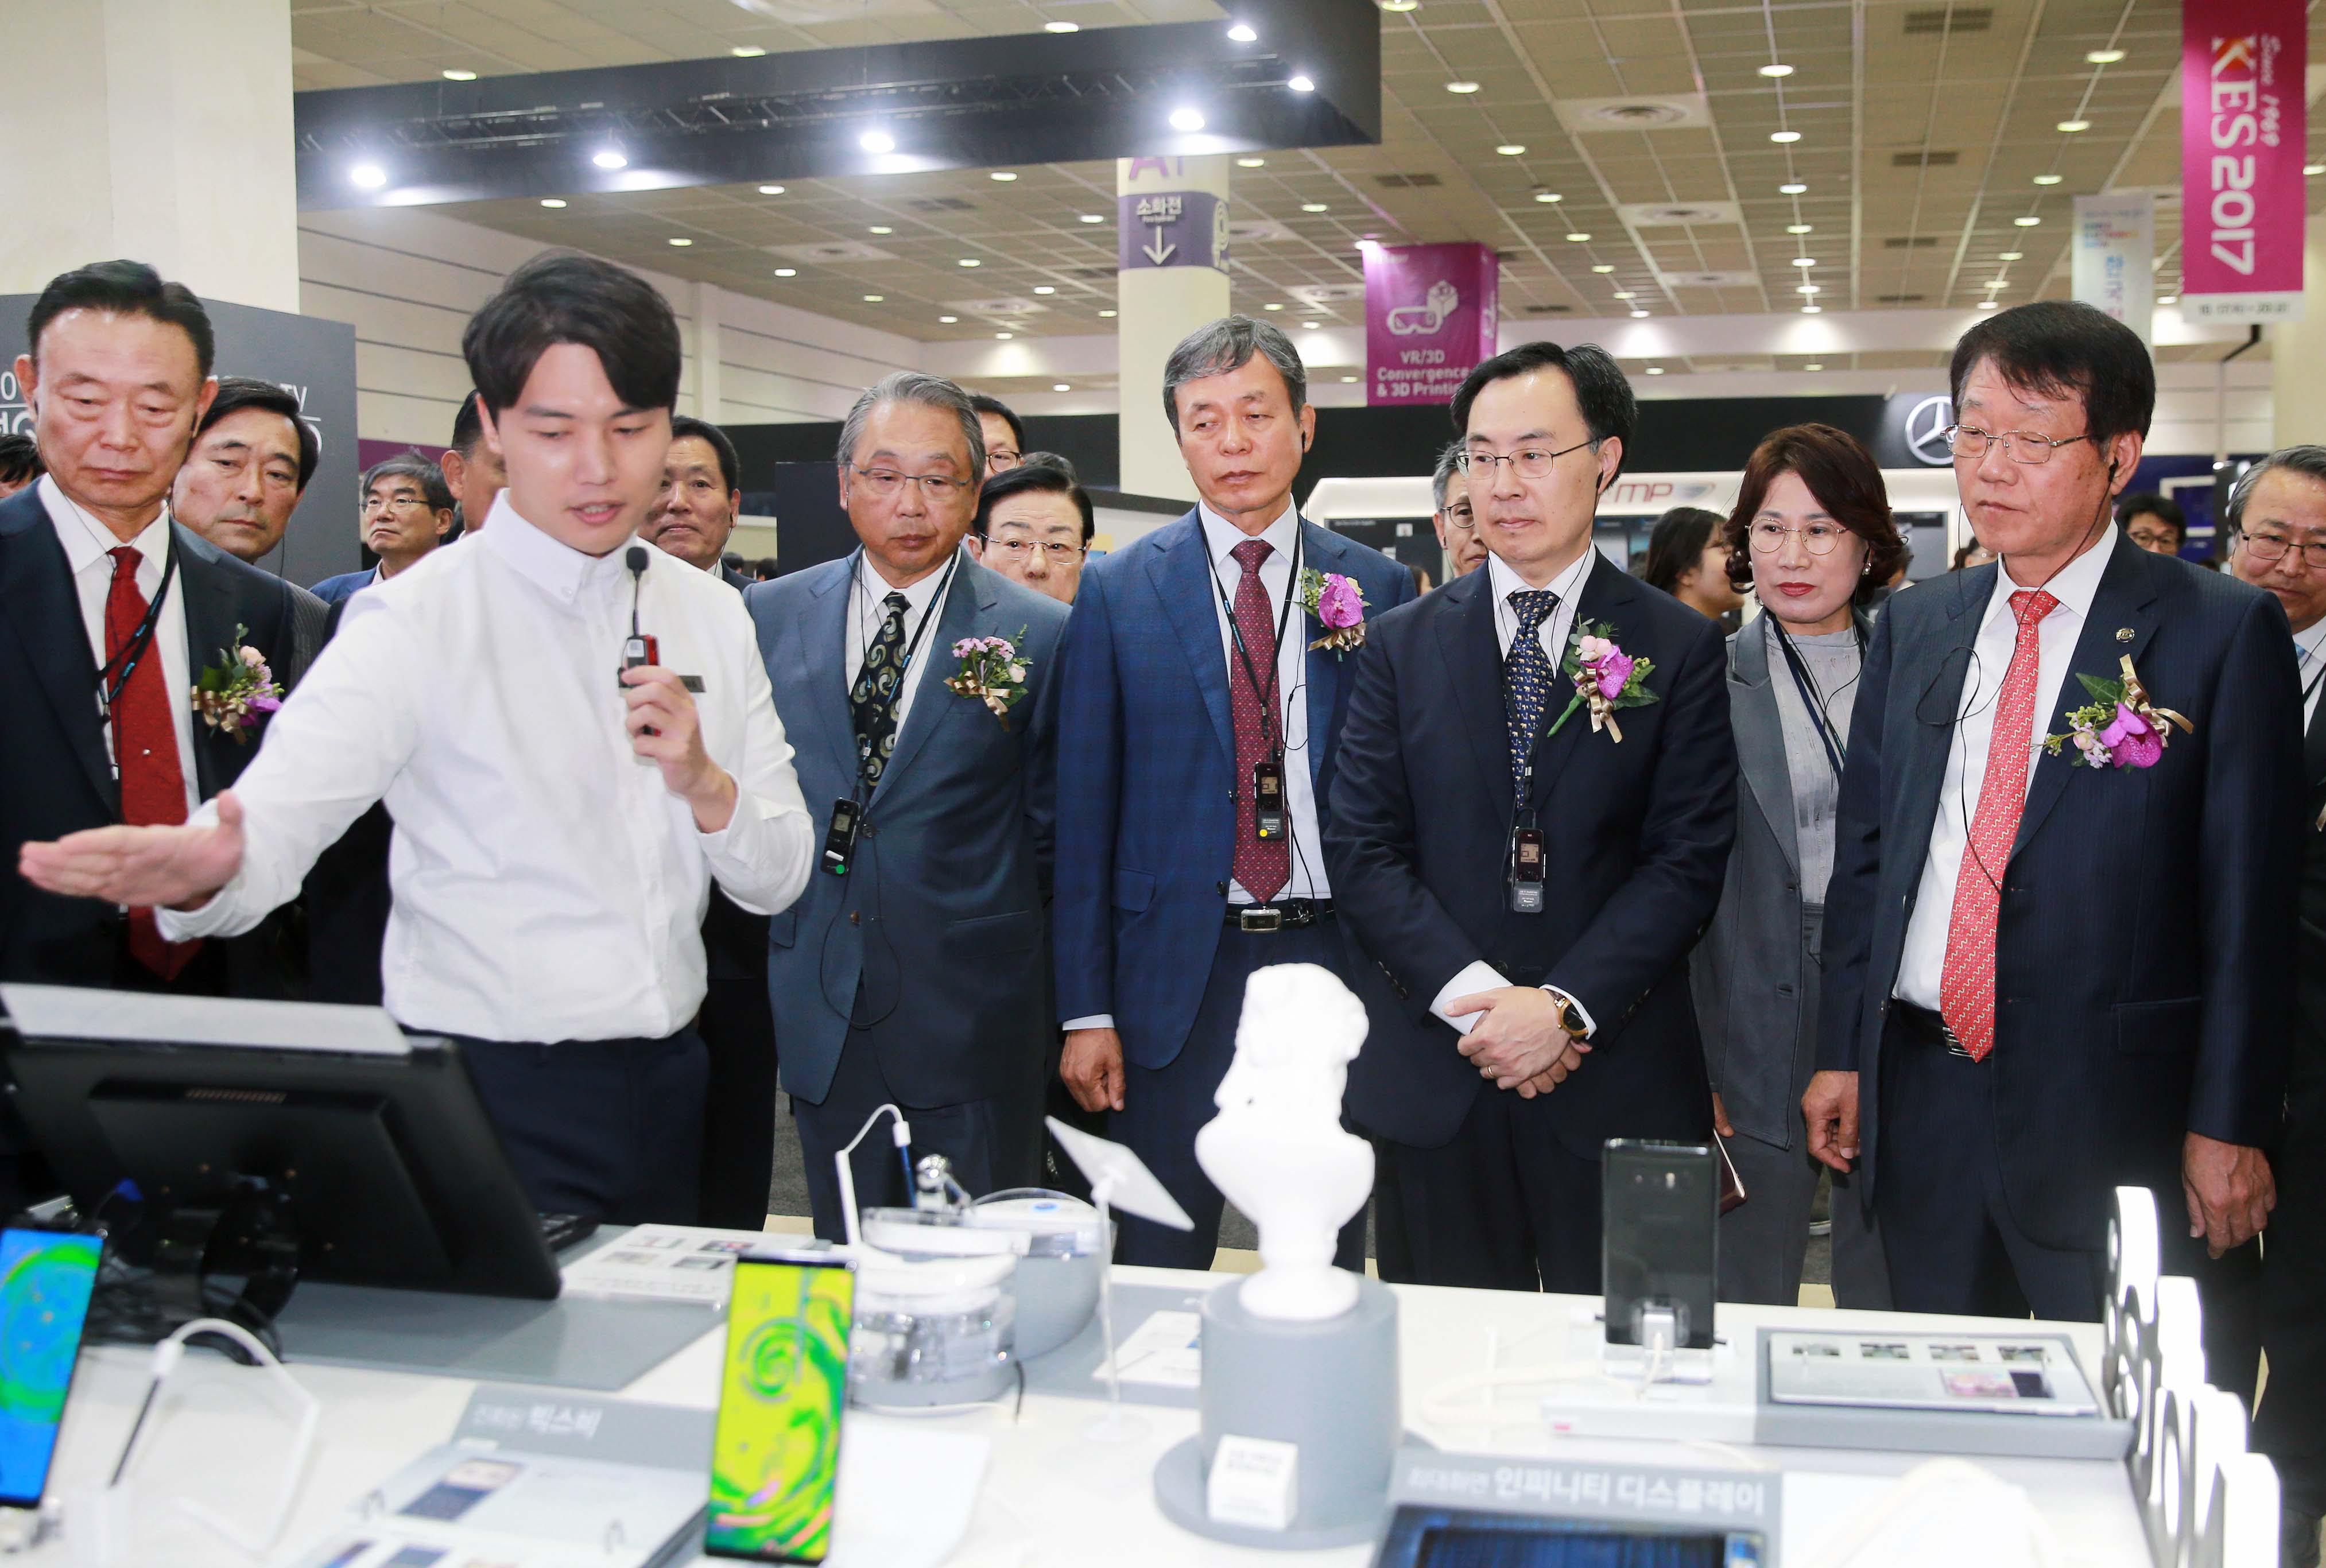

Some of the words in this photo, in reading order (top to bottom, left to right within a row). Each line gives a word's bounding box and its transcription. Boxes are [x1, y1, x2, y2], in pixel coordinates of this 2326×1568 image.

[2211, 36, 2257, 149] KES
[2211, 154, 2256, 275] 2017
[1400, 349, 1445, 366] VR/3D
[1377, 367, 1470, 383] Convergence
[1377, 383, 1387, 398] &
[1391, 383, 1410, 397] 3D
[1494, 1466, 1608, 1505] 인피니티
[1616, 1474, 1764, 1516] 디스플레이
